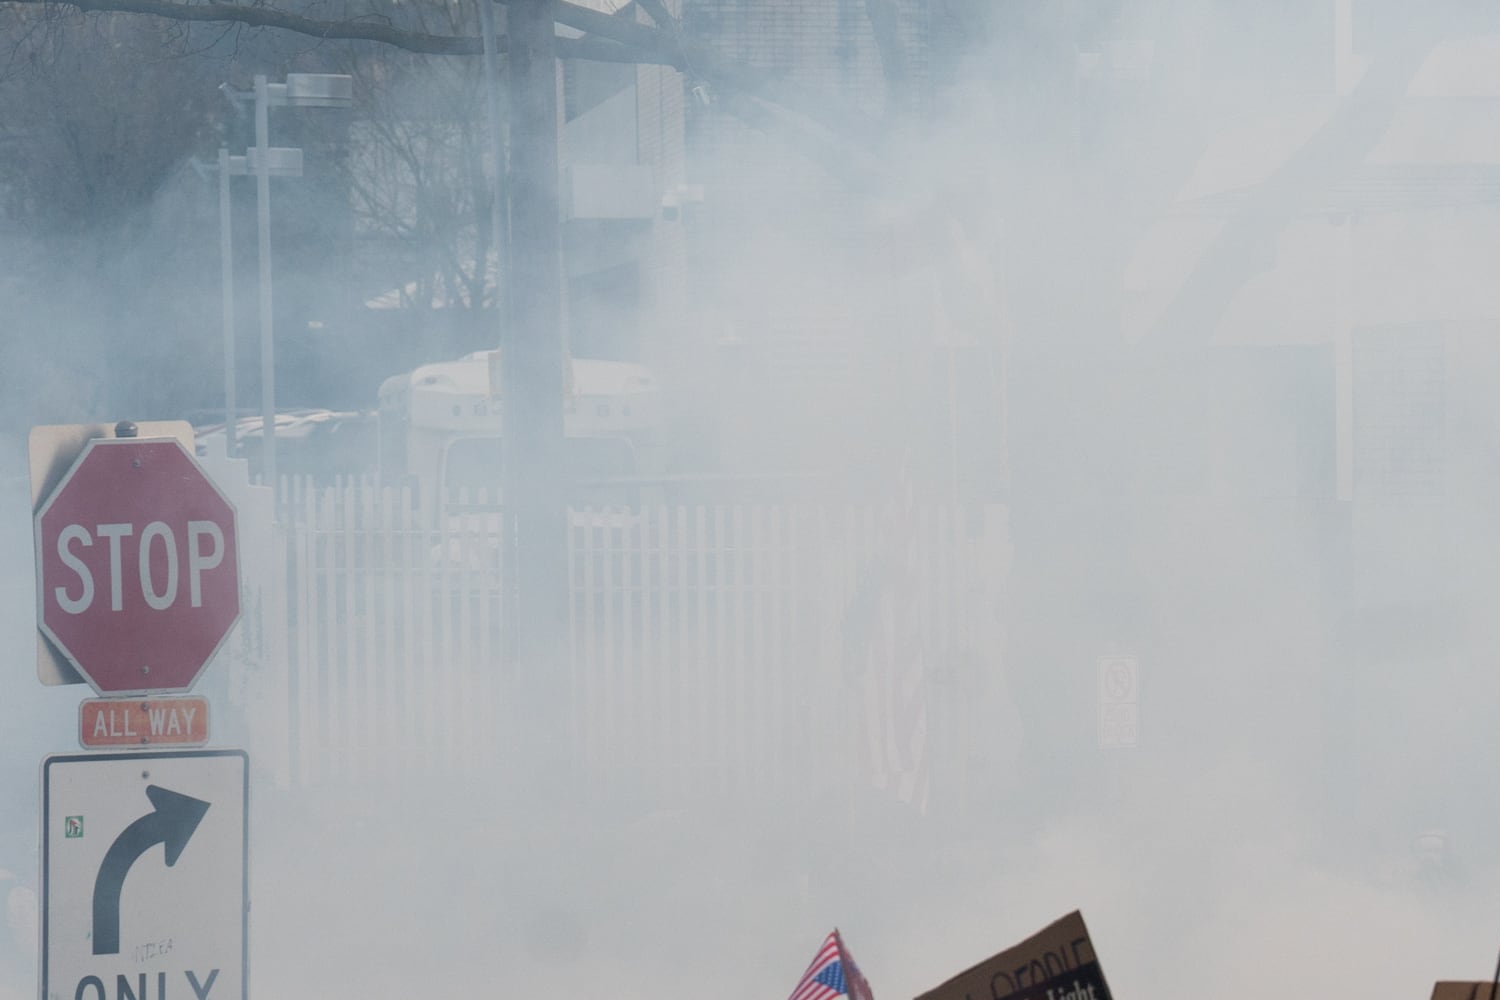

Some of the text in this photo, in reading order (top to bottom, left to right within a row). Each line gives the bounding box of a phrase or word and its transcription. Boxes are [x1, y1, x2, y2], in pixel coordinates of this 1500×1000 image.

[55, 520, 225, 614] STOP
[94, 708, 196, 737] ALL WAY
